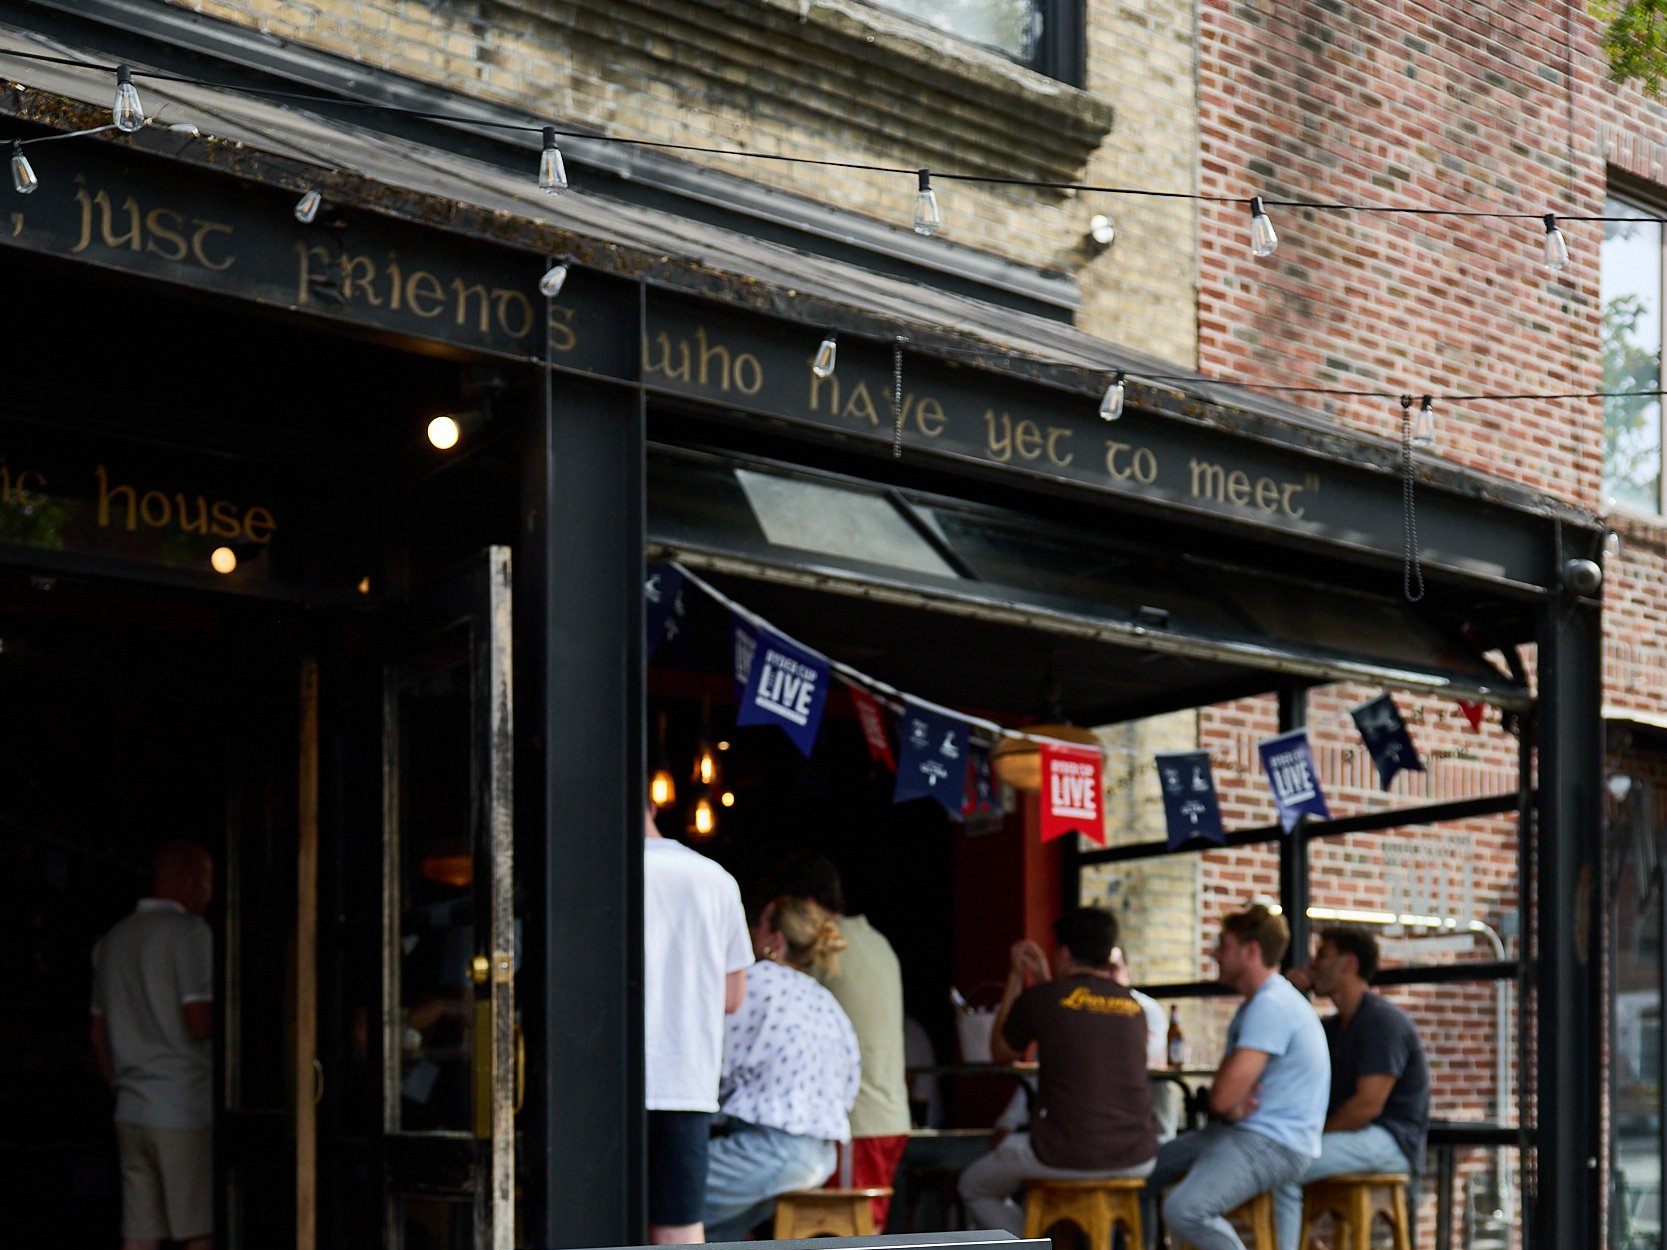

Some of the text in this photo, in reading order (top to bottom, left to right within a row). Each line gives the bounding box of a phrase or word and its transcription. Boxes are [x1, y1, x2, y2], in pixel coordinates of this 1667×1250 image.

[72, 173, 236, 271] just
[642, 327, 764, 396] who
[984, 409, 1074, 468] yet
[1105, 439, 1158, 485] to
[96, 463, 278, 544] house
[757, 664, 815, 716] LIVE
[1050, 773, 1096, 809] LIVE
[1273, 762, 1314, 797] LIVE
